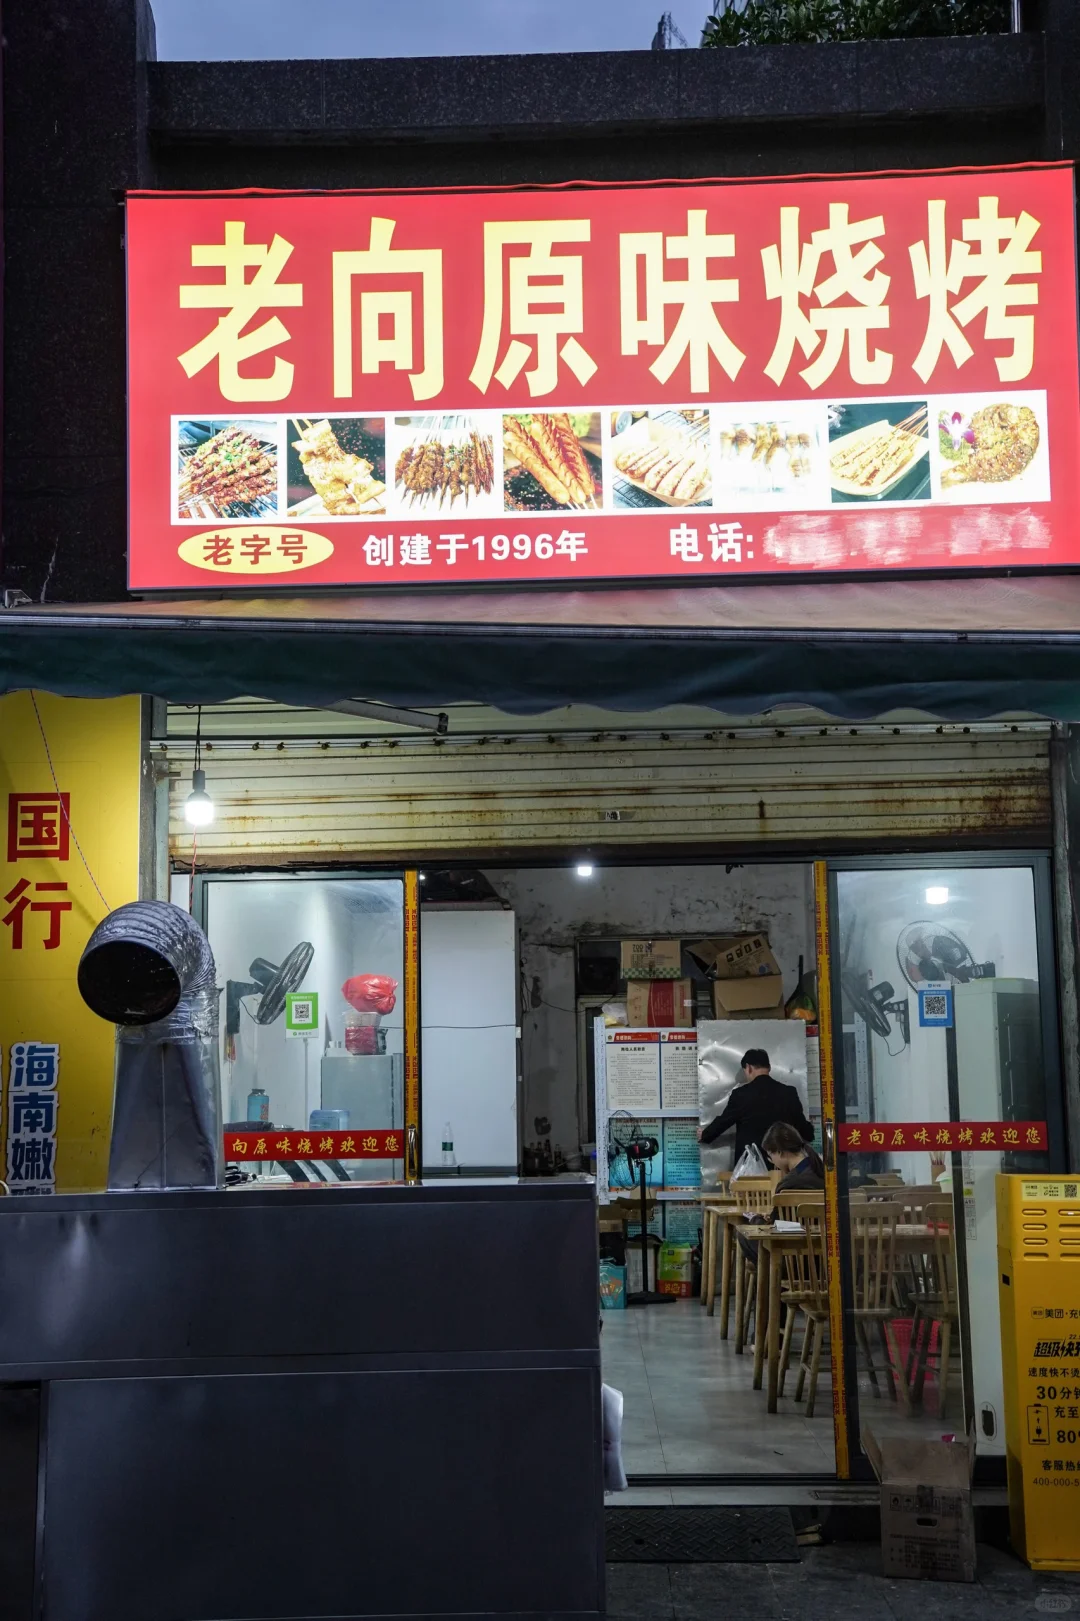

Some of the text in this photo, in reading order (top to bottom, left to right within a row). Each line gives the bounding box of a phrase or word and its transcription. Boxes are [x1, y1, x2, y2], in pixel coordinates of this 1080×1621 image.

[177, 196, 1043, 402] 老向原味烧烤
[202, 533, 309, 566] 老字号
[362, 529, 589, 566] 创建于1996年
[11, 1045, 55, 1196] 海南嫩
[231, 1135, 399, 1155] 向原味烧烤欢迎您
[846, 1126, 1041, 1146] 老向原味烧烤欢迎您
[1045, 1308, 1080, 1319] 美团·充
[1056, 1430, 1080, 1444] 80
